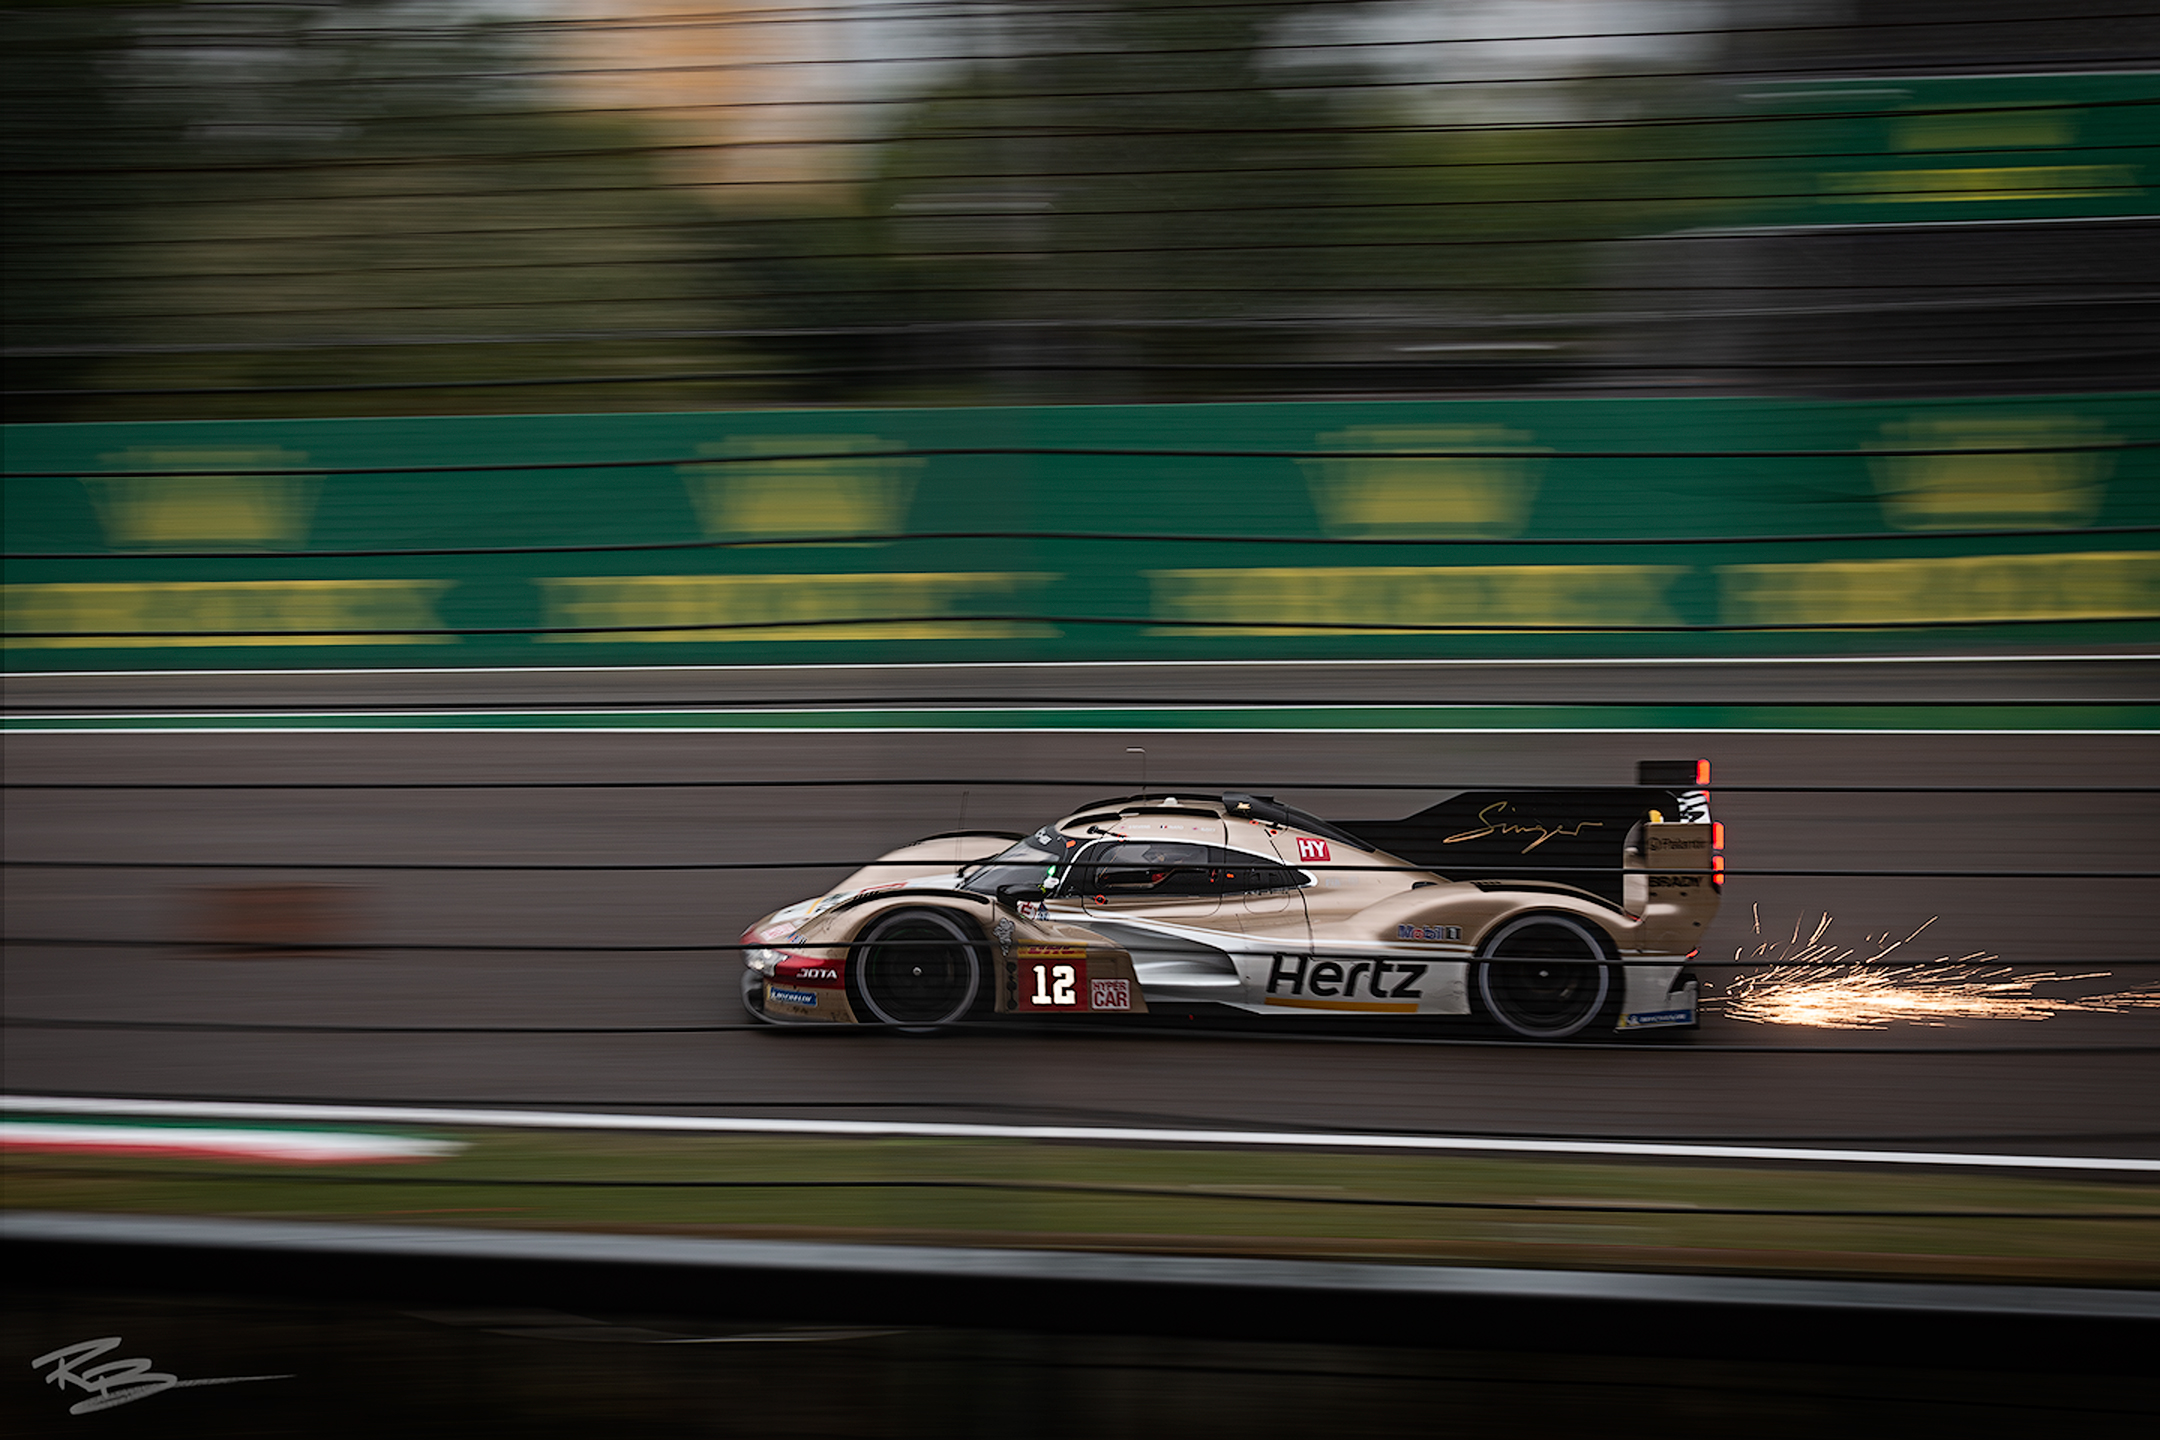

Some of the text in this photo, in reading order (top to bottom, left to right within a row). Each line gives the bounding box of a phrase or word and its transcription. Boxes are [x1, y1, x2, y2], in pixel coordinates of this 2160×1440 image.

[1443, 801, 1603, 854] Singer
[1299, 839, 1325, 857] HY
[1397, 924, 1444, 940] Mobil
[796, 968, 838, 979] JOTA
[1266, 953, 1428, 998] Hertz
[1031, 964, 1077, 1005] 12
[1093, 981, 1126, 991] HYPER
[1094, 991, 1127, 1007] CAR
